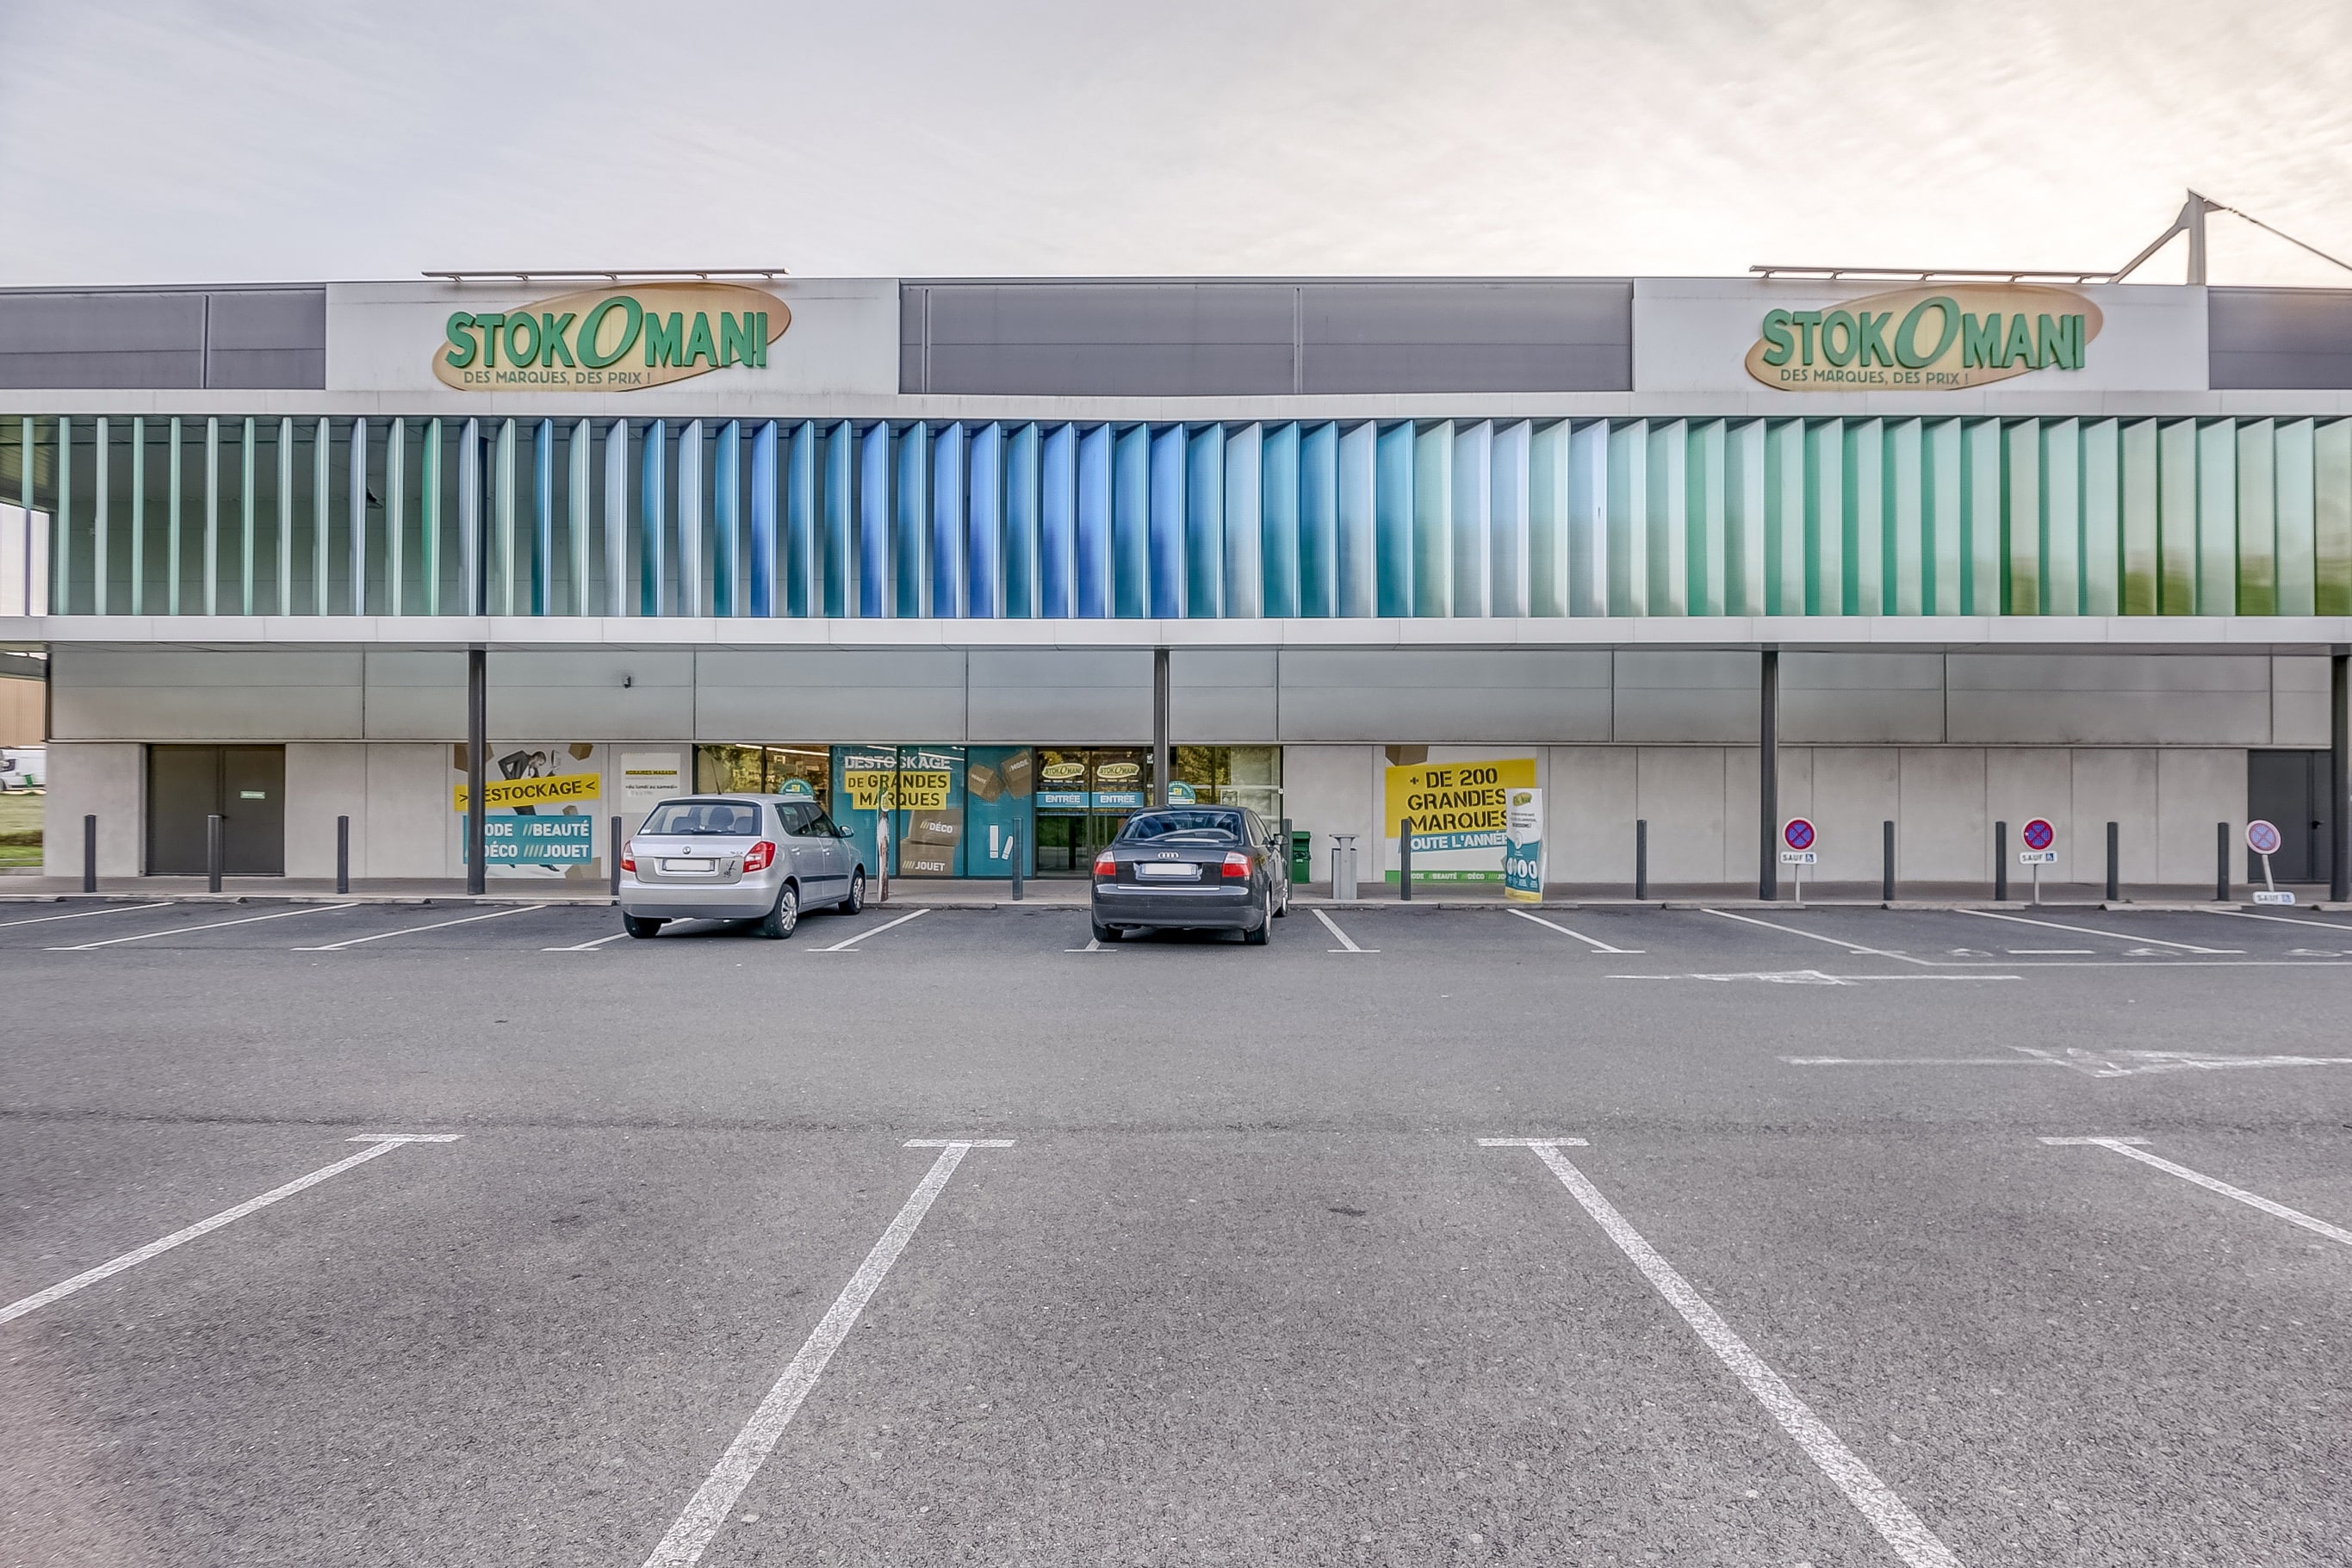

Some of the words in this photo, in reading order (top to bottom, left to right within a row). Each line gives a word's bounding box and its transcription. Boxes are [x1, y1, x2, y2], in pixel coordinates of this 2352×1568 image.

[446, 295, 769, 369] STOKOMANI
[1762, 296, 2085, 369] STOKOMANI
[464, 371, 490, 383] DES
[496, 371, 570, 386] MARQUES,
[575, 372, 602, 384] DES
[608, 372, 642, 384] PRIX
[1781, 369, 1808, 381] DES
[1814, 370, 1889, 385] MARQUES,
[1894, 372, 1920, 384] DES
[1926, 372, 1959, 384] PRIX
[848, 778, 864, 788] DE
[867, 774, 947, 788] GRANDES
[1426, 771, 1453, 788] DE
[1459, 768, 1498, 786] 200
[1046, 793, 1081, 803] ENTRÉE
[1100, 793, 1135, 803] ENTRÉE
[1407, 788, 1505, 810] GRANDES
[485, 823, 513, 837] ODE
[1411, 836, 1448, 850] OUTE
